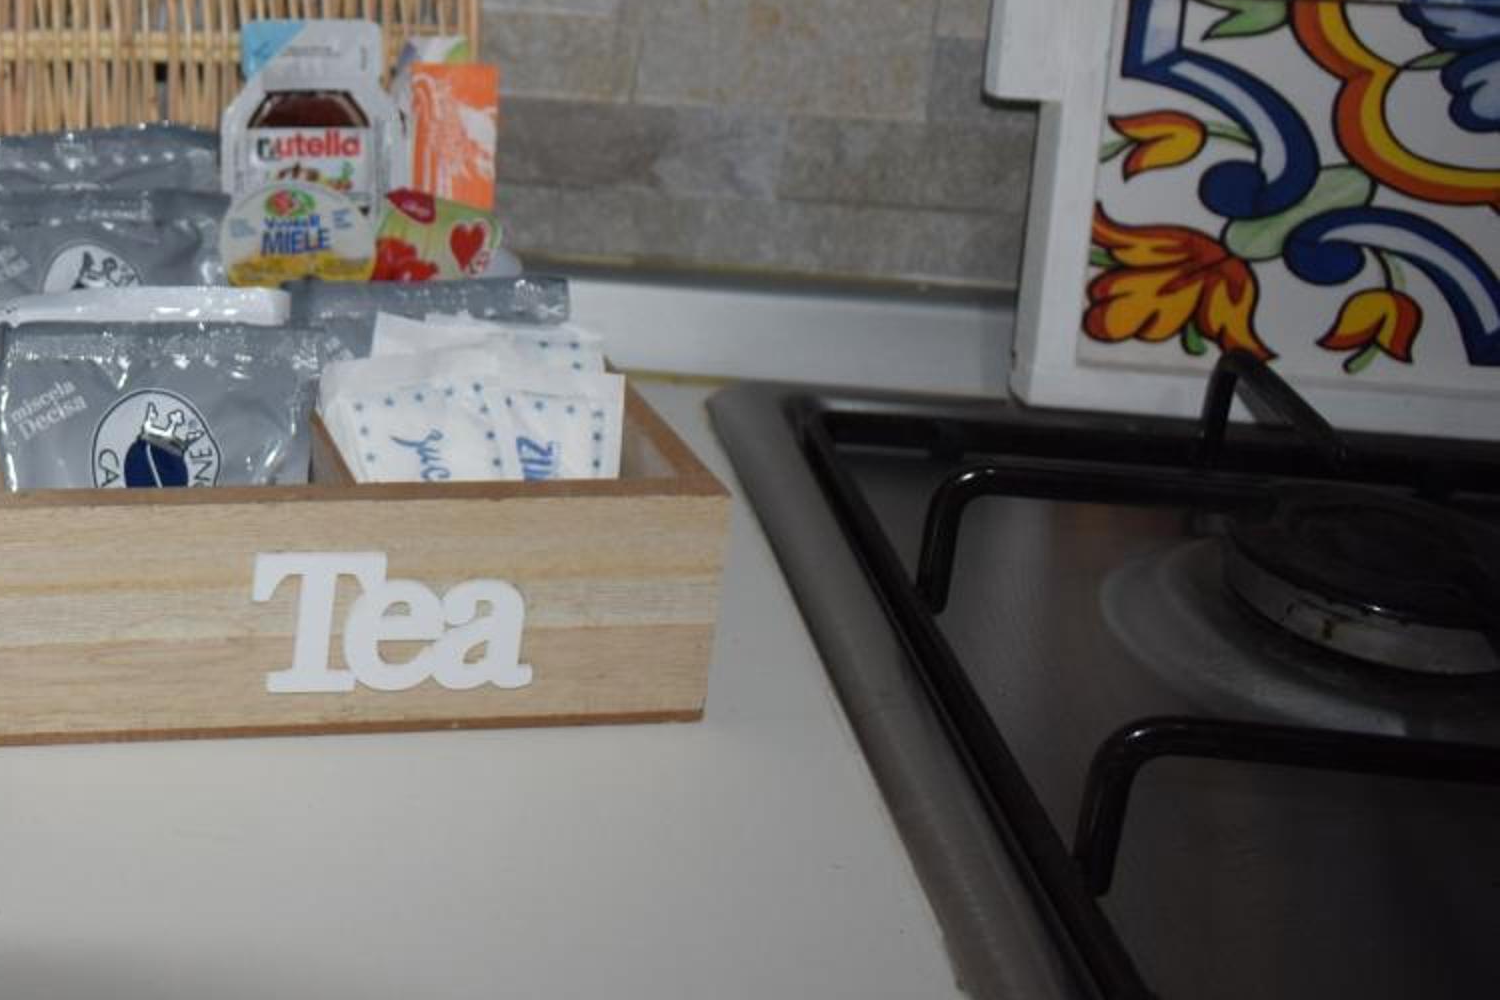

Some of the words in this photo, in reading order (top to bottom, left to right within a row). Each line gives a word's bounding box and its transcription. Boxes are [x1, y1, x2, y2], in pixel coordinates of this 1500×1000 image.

[257, 131, 361, 160] nutella
[261, 228, 332, 257] MIELE
[10, 379, 77, 424] miscela
[17, 394, 88, 441] Decisa
[252, 551, 533, 693] Tea
